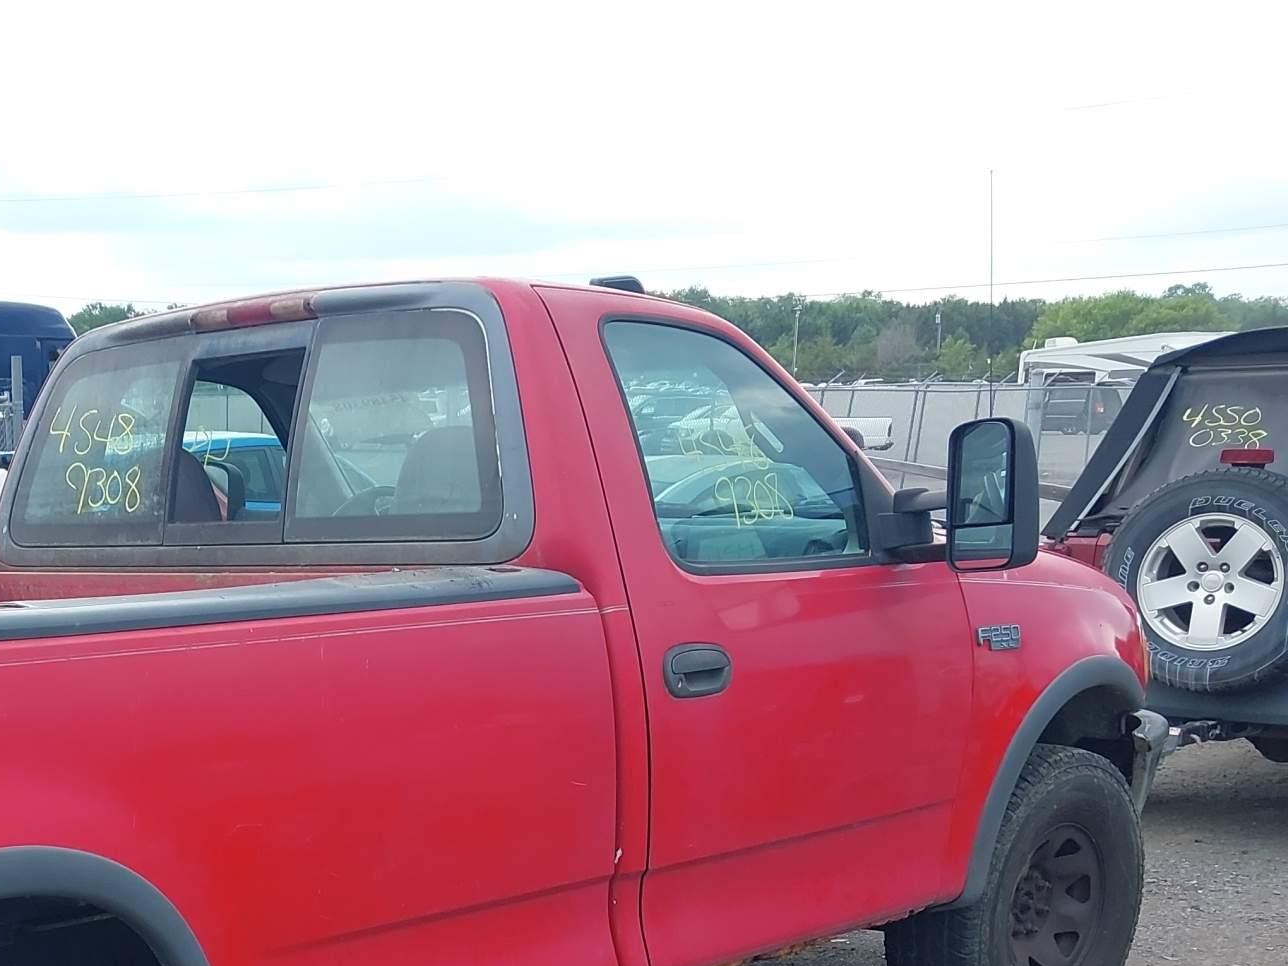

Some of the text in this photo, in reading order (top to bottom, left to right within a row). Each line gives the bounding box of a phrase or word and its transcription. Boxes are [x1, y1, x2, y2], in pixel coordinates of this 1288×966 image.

[50, 402, 136, 455] 4548
[1183, 403, 1262, 428] 4550
[1189, 428, 1268, 450] 0338
[65, 462, 141, 514] 9308
[714, 472, 794, 529] 9308
